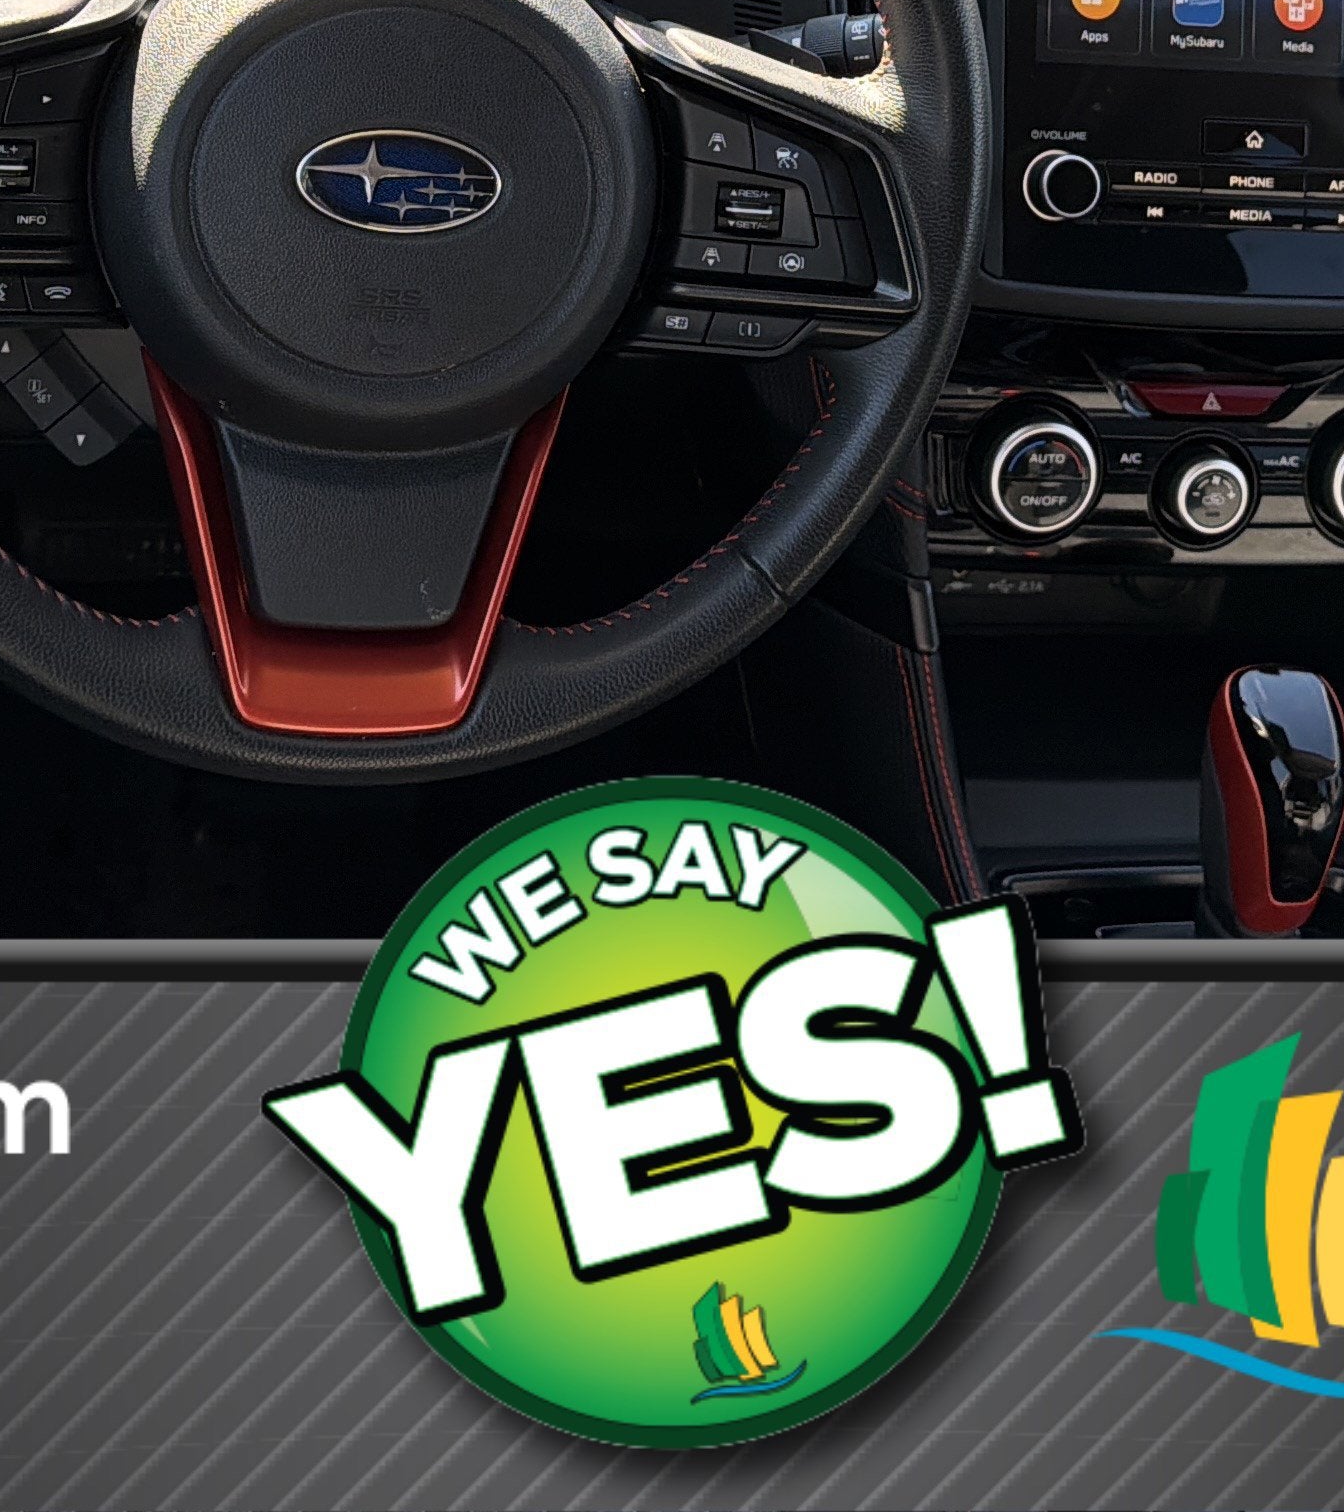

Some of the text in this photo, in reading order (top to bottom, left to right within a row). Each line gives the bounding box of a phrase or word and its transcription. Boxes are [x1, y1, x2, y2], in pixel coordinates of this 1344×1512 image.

[1080, 29, 1109, 45] Apps
[1169, 34, 1225, 50] MySubaru
[1282, 39, 1314, 54] Media
[1133, 170, 1178, 185] RADIO
[1228, 175, 1275, 189] PHONE
[16, 215, 46, 225] INFO
[1229, 209, 1273, 223] MEDIA
[1029, 453, 1065, 465] AUTO
[1120, 453, 1143, 465] A/C
[1020, 494, 1067, 507] ON/OFF
